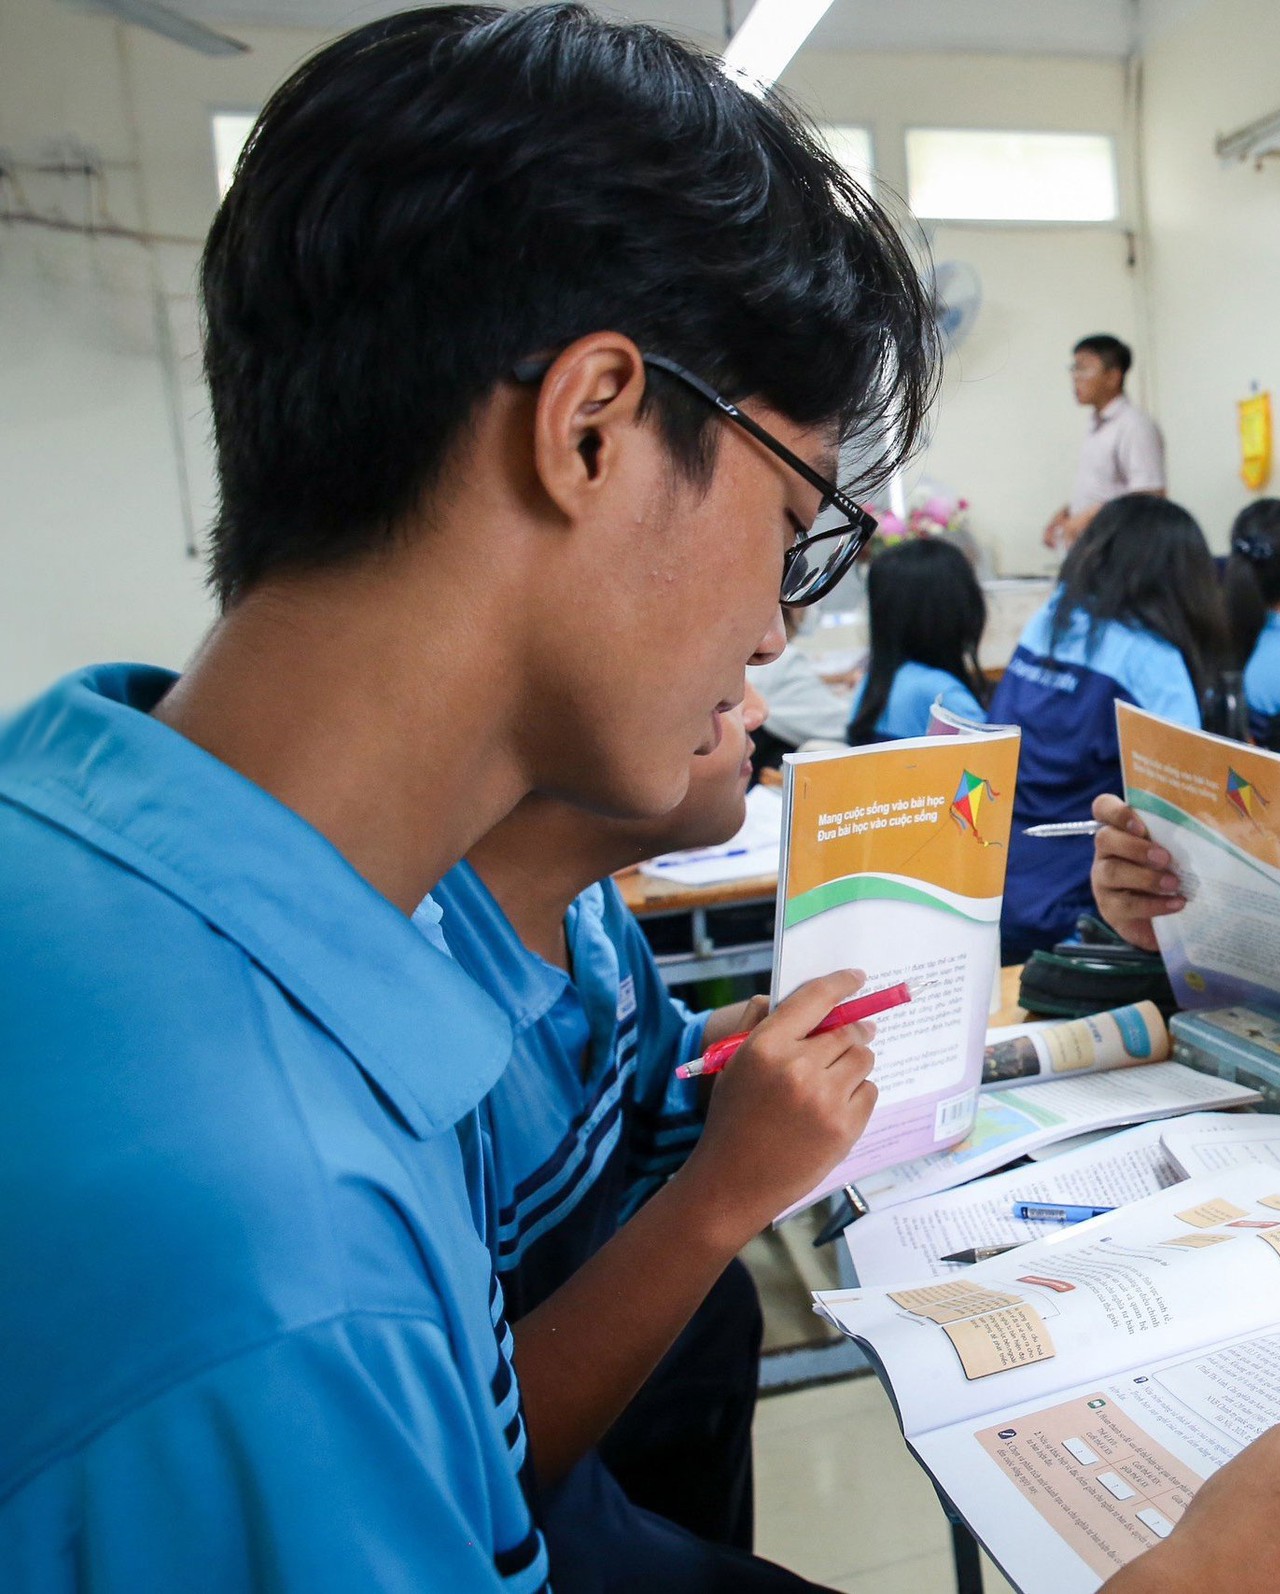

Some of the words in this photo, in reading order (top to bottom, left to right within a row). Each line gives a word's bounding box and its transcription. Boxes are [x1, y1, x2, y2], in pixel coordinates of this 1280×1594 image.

[819, 812, 842, 826] Mang
[844, 806, 865, 821] cuộc
[866, 801, 890, 815] sống
[891, 799, 908, 811] vào
[910, 797, 925, 809] bài
[926, 796, 945, 807] học
[817, 829, 836, 842] Đưa
[838, 824, 851, 837] bài
[852, 822, 868, 835] học
[870, 817, 887, 829] vào
[889, 814, 912, 827] cuộc
[914, 809, 938, 823] sống
[1106, 1312, 1121, 1329] giới.
[1121, 1310, 1129, 1319] tư
[1125, 1319, 1140, 1335] bản
[1129, 1301, 1142, 1319] quan
[1138, 1320, 1148, 1331] hệ
[1146, 1306, 1160, 1328] chỉnh
[1155, 1296, 1167, 1313] kinh
[1163, 1313, 1173, 1325] tế,
[1026, 1347, 1034, 1358] cho
